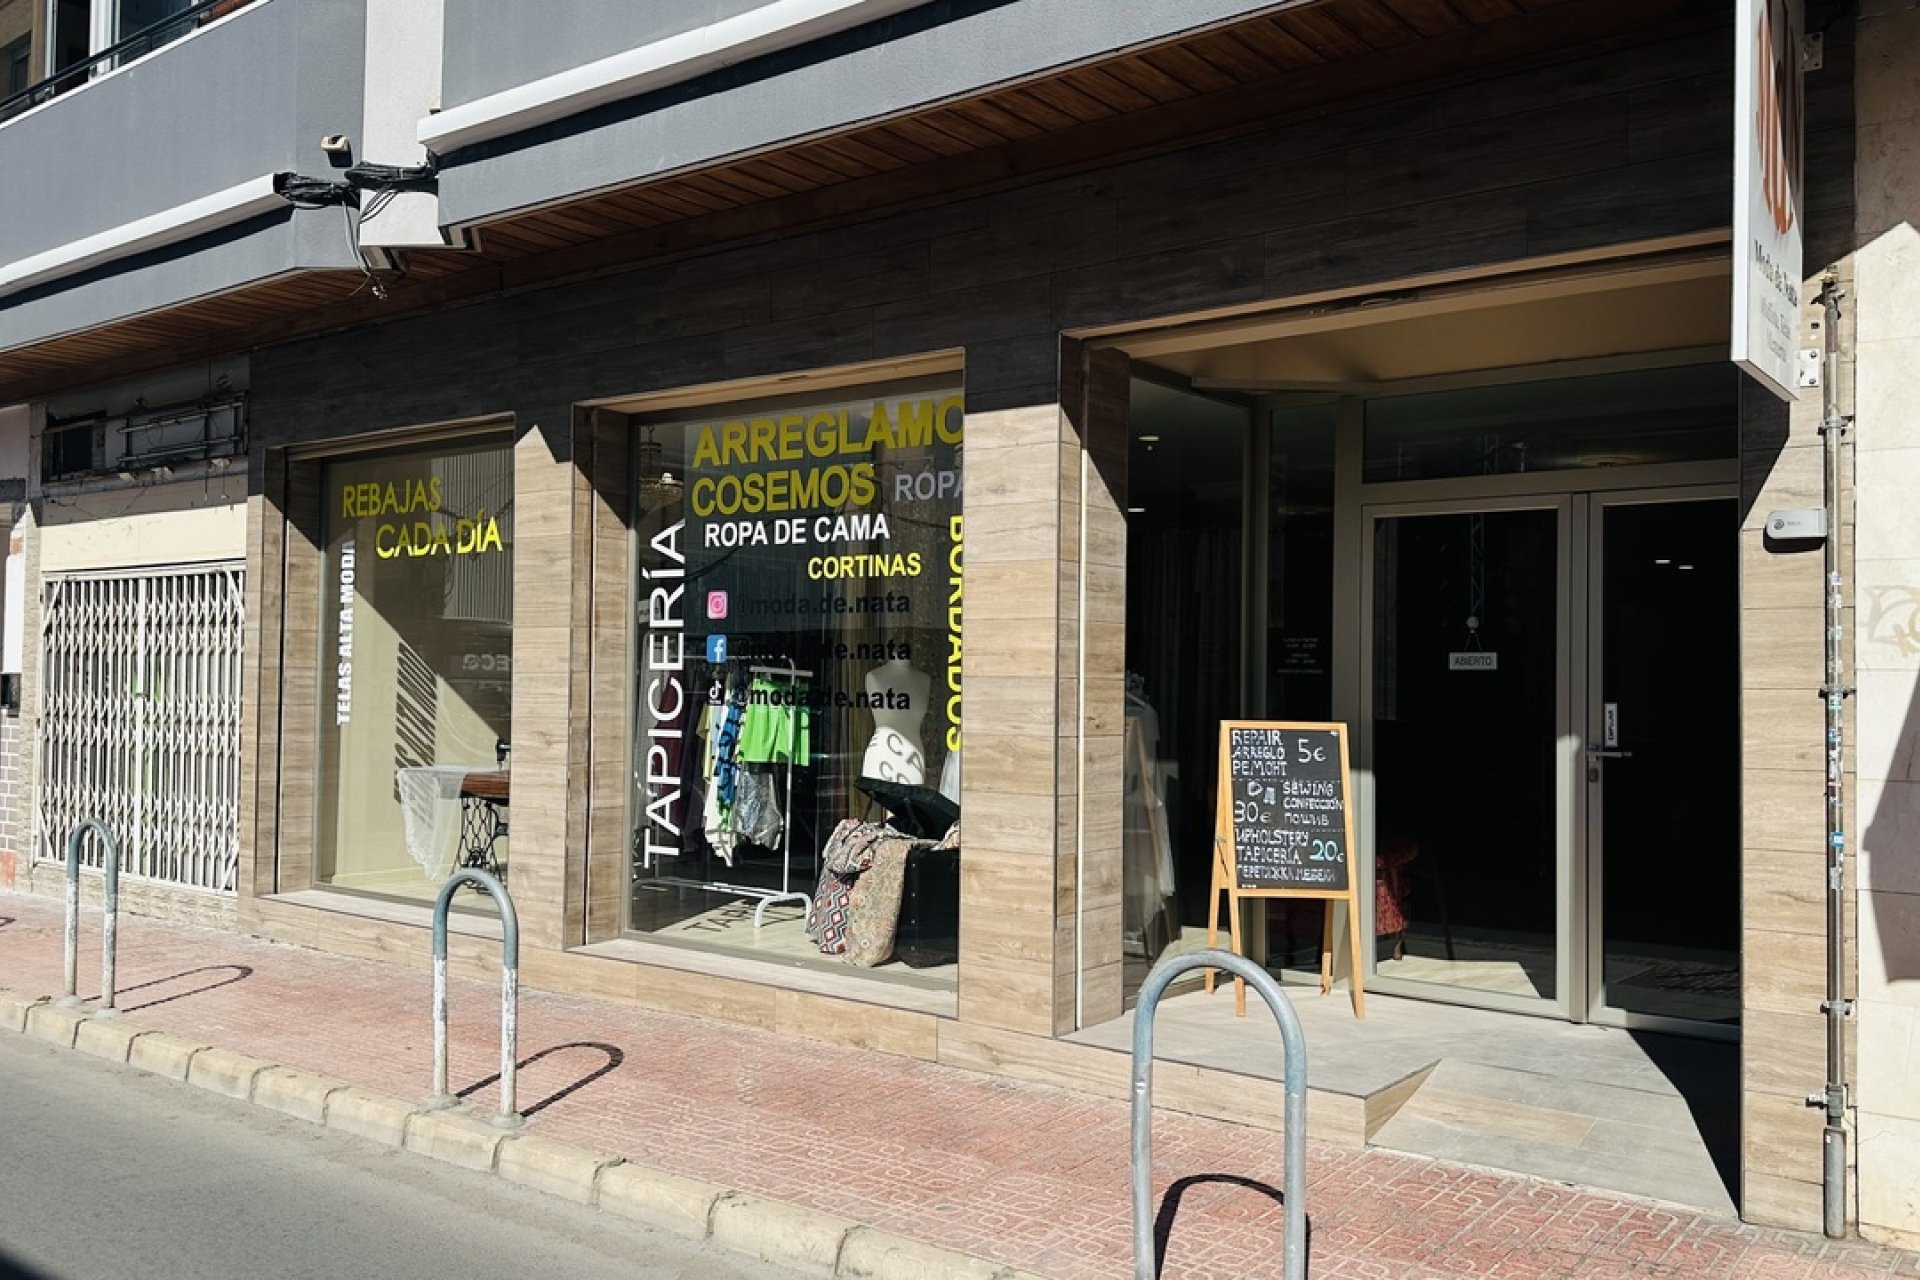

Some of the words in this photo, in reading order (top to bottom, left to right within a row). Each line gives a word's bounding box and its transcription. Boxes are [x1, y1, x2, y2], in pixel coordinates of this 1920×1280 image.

[692, 394, 963, 468] ARREGLAMO
[342, 475, 441, 518] REBAJAS
[692, 461, 876, 517] COSEMOS
[375, 522, 450, 559] CADA
[456, 507, 503, 555] DÍA
[704, 519, 768, 548] ROPA
[774, 518, 807, 545] DE
[814, 512, 890, 544] CAMA
[339, 539, 356, 603] MODA
[807, 552, 922, 581] CORTINAS
[338, 607, 354, 657] ALTA
[1454, 655, 1493, 666] ABIERTO
[336, 662, 352, 726] TELAS
[641, 517, 687, 870] TAPICERÍA
[735, 686, 911, 711] @modade.nata
[1232, 730, 1284, 746] REPAIR
[1298, 738, 1327, 763] 5€
